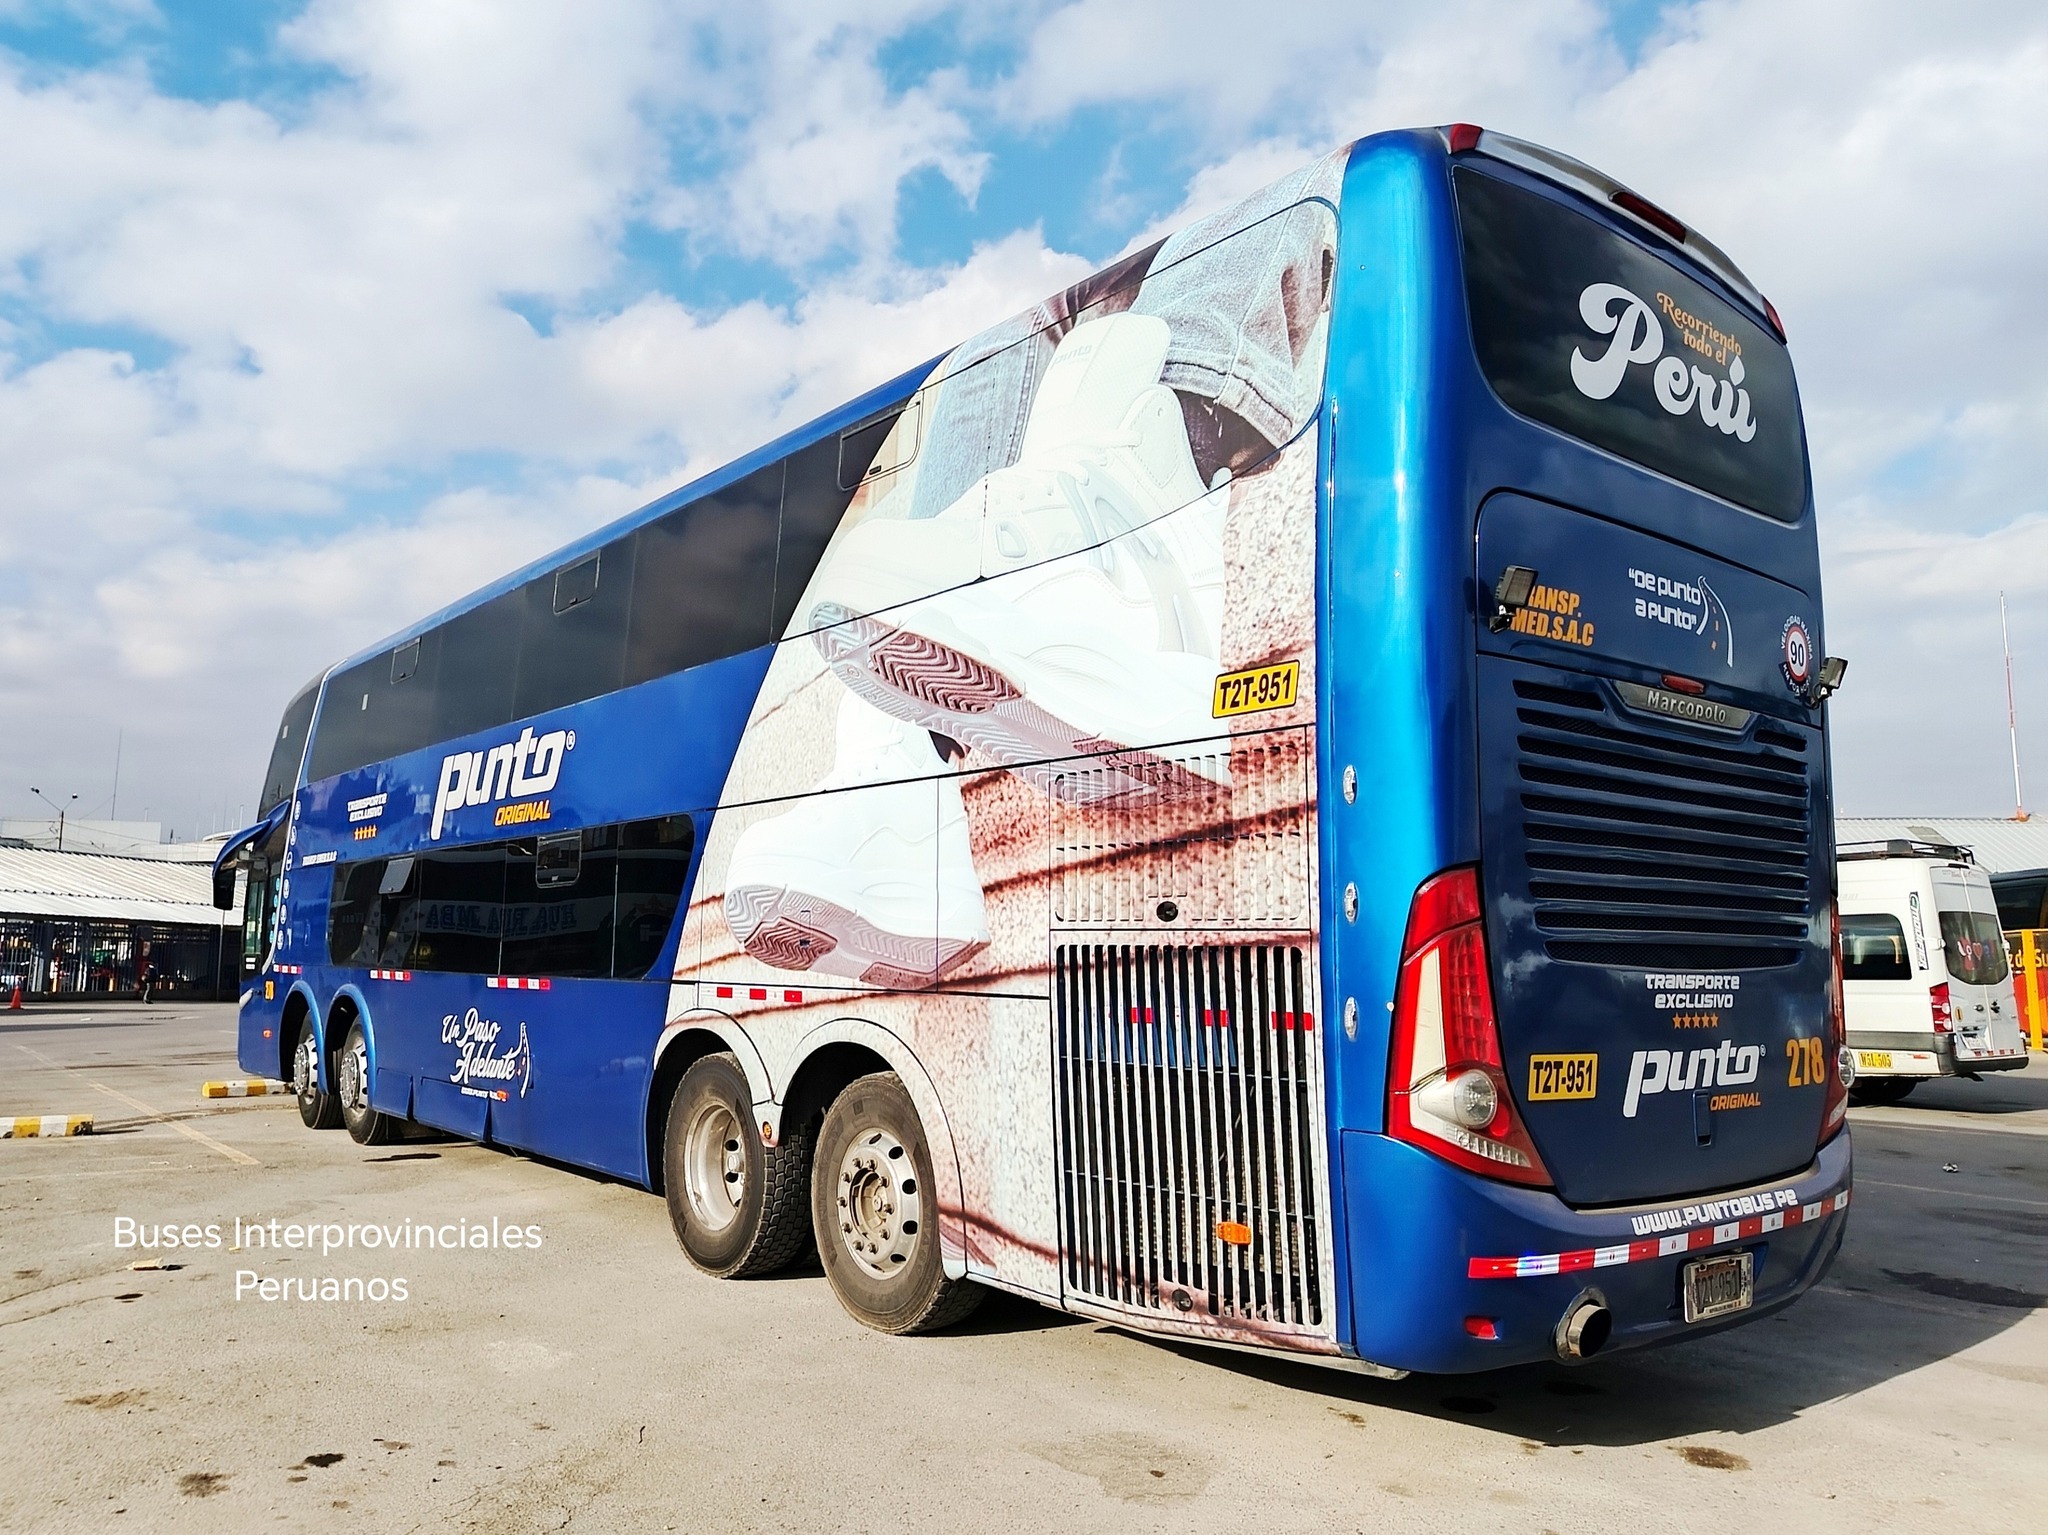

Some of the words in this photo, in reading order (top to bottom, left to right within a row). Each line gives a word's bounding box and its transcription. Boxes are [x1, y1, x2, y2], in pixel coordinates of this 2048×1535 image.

[1656, 292, 1741, 356] Recorriendo
[1683, 328, 1712, 357] todo
[1715, 347, 1726, 365] el
[1528, 585, 1582, 617] ANSP.
[1790, 641, 1804, 667] 90
[1220, 669, 1291, 710] T2T-951
[1648, 691, 1726, 722] Marcopolo
[430, 727, 567, 840] punto
[494, 800, 551, 826] ORIGINAL
[442, 1015, 460, 1044] Un
[456, 1007, 501, 1048] Paso
[450, 1042, 520, 1084] Adelante
[1533, 1060, 1594, 1094] T2T-951
[1623, 1040, 1760, 1118] punto
[1786, 1037, 1824, 1087] 278
[1710, 1093, 1761, 1112] ORIGINAL
